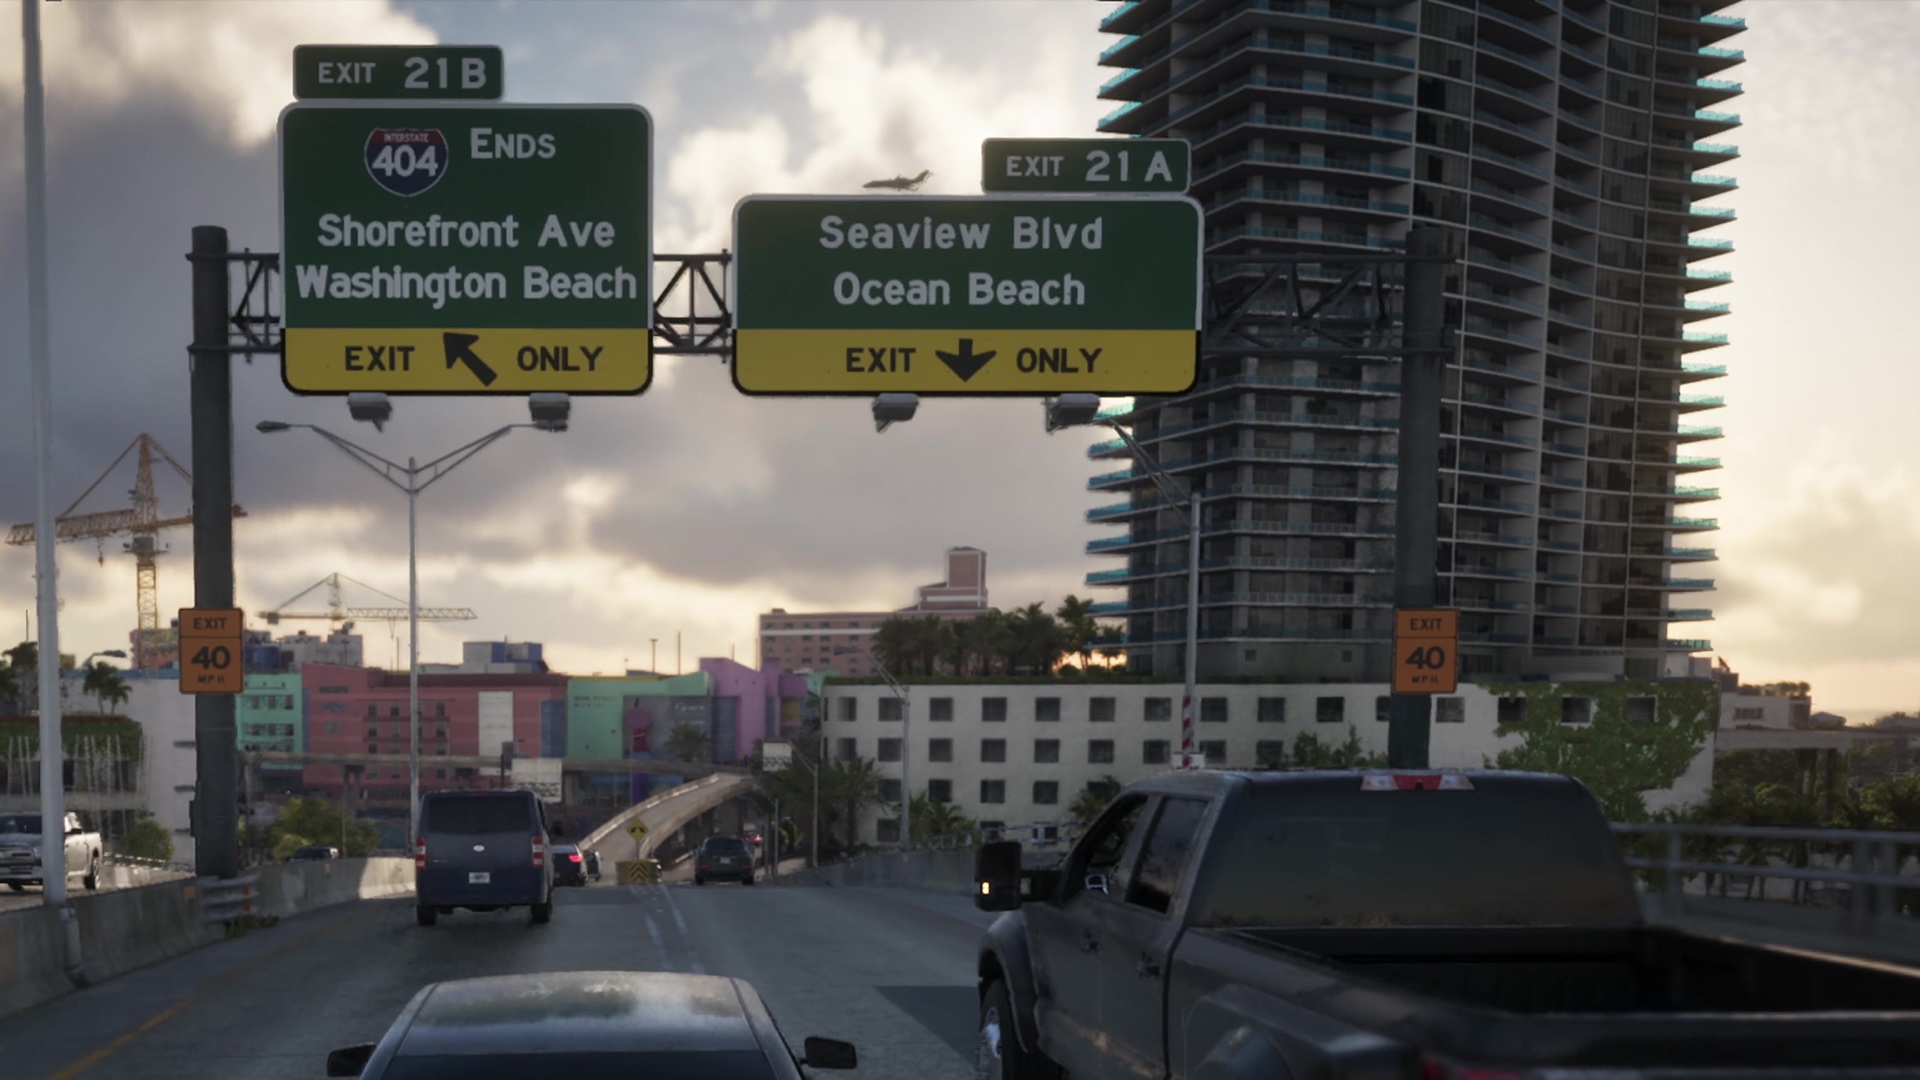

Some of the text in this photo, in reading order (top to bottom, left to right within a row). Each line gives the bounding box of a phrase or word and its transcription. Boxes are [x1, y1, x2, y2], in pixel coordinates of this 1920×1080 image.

[318, 56, 486, 89] EXIT 21B
[383, 133, 429, 143] INTERSTATE
[372, 144, 439, 177] 404
[1006, 155, 1064, 177] EXIT
[317, 213, 616, 248] Shorefront Ave
[819, 215, 1103, 249] Seaview Blvd
[296, 264, 636, 309] Washington Beach
[833, 271, 1086, 306] Ocean Beach
[344, 345, 604, 372] EXIT ONLY
[845, 347, 1103, 373] EXIT ONLY
[193, 617, 227, 630] EXIT
[1410, 618, 1442, 631] EXIT
[191, 645, 231, 670] 40
[1405, 645, 1446, 670] 40
[198, 675, 225, 683] MPH
[1411, 675, 1438, 684] MPH
